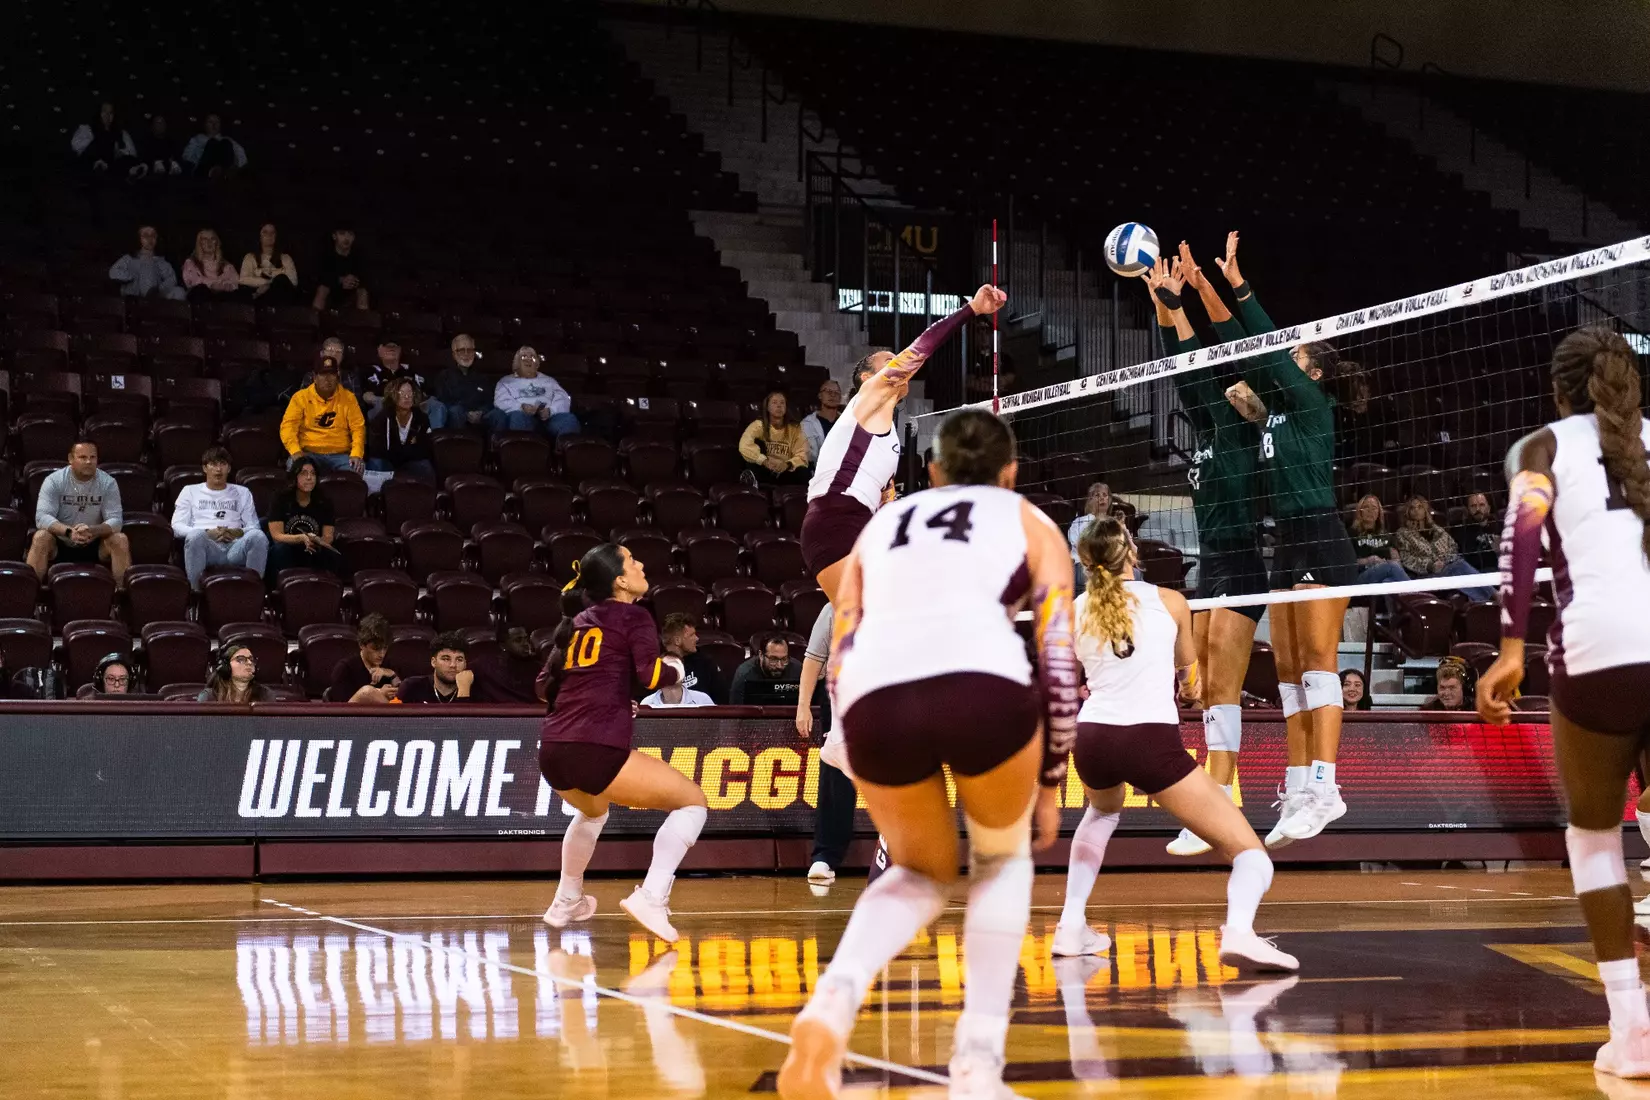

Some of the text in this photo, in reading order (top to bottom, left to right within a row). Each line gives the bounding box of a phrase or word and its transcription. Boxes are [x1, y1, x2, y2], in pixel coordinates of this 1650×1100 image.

[1096, 357, 1178, 387] CENTRAL MICHIGAN VOLLEYBALL
[888, 500, 975, 551] 14
[563, 626, 604, 670] 10
[237, 739, 521, 818] WELCOME
